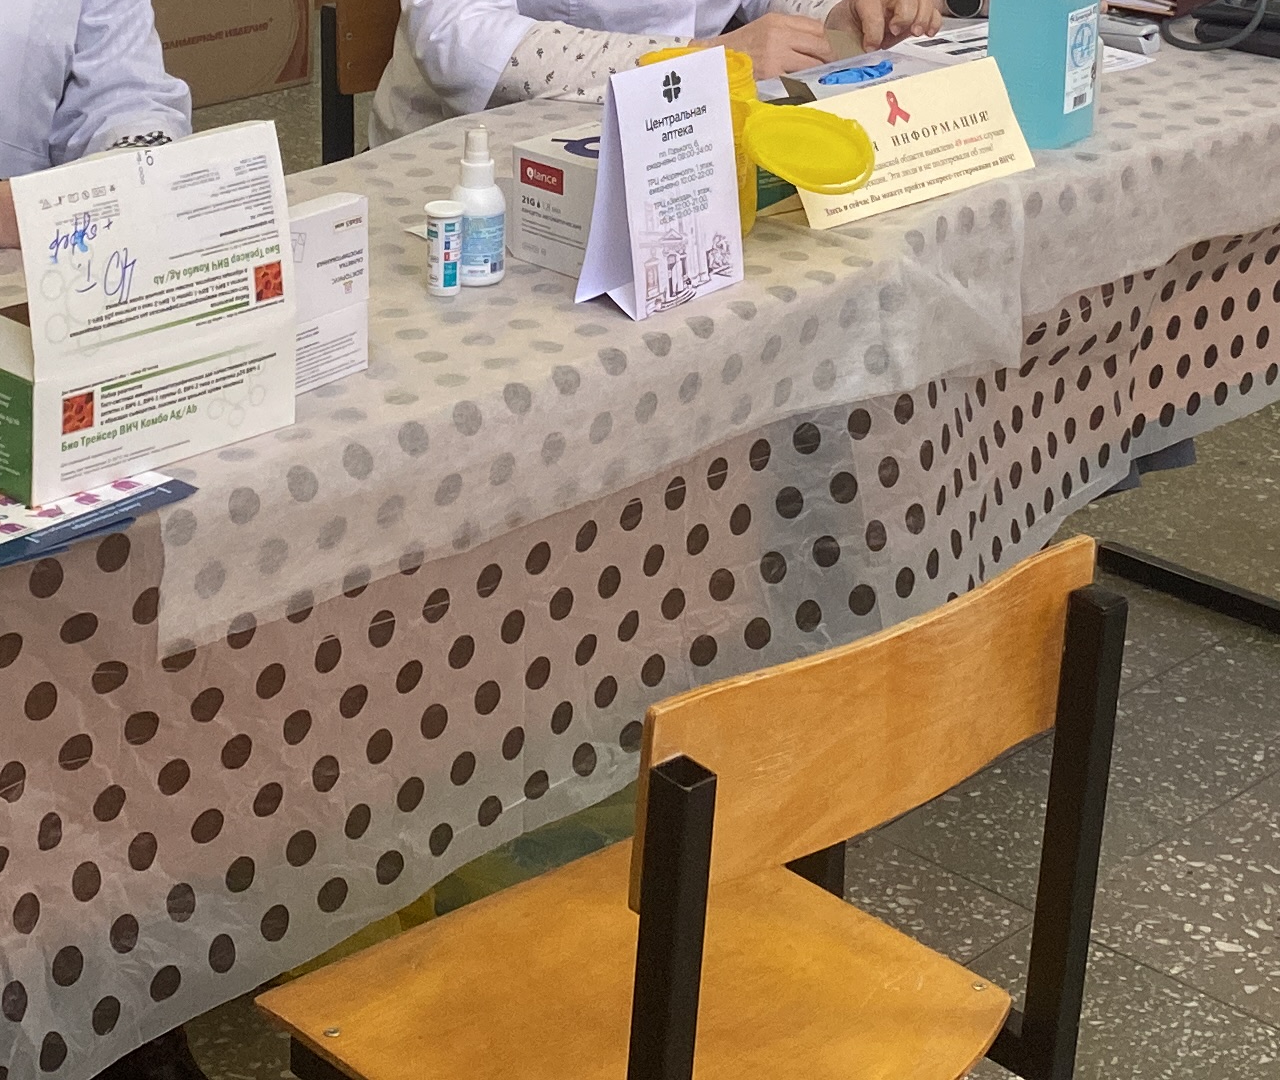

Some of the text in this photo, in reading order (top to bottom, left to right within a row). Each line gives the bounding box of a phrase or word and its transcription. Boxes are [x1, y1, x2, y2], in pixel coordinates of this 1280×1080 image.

[163, 31, 223, 50] ОЛИМЕРНЫЕ
[645, 105, 707, 132] Центральная
[662, 124, 694, 142] аптека
[891, 111, 989, 147] ИНФОРМАЦИЯ!
[522, 195, 535, 206] 21G
[212, 257, 230, 270] ВИЧ
[231, 248, 264, 264] Трейсер
[153, 269, 180, 285] Ag/Ab
[182, 263, 209, 277] Комбо
[62, 403, 197, 452] Био Трейсер ВИЧ Комбо Ag/Ab
